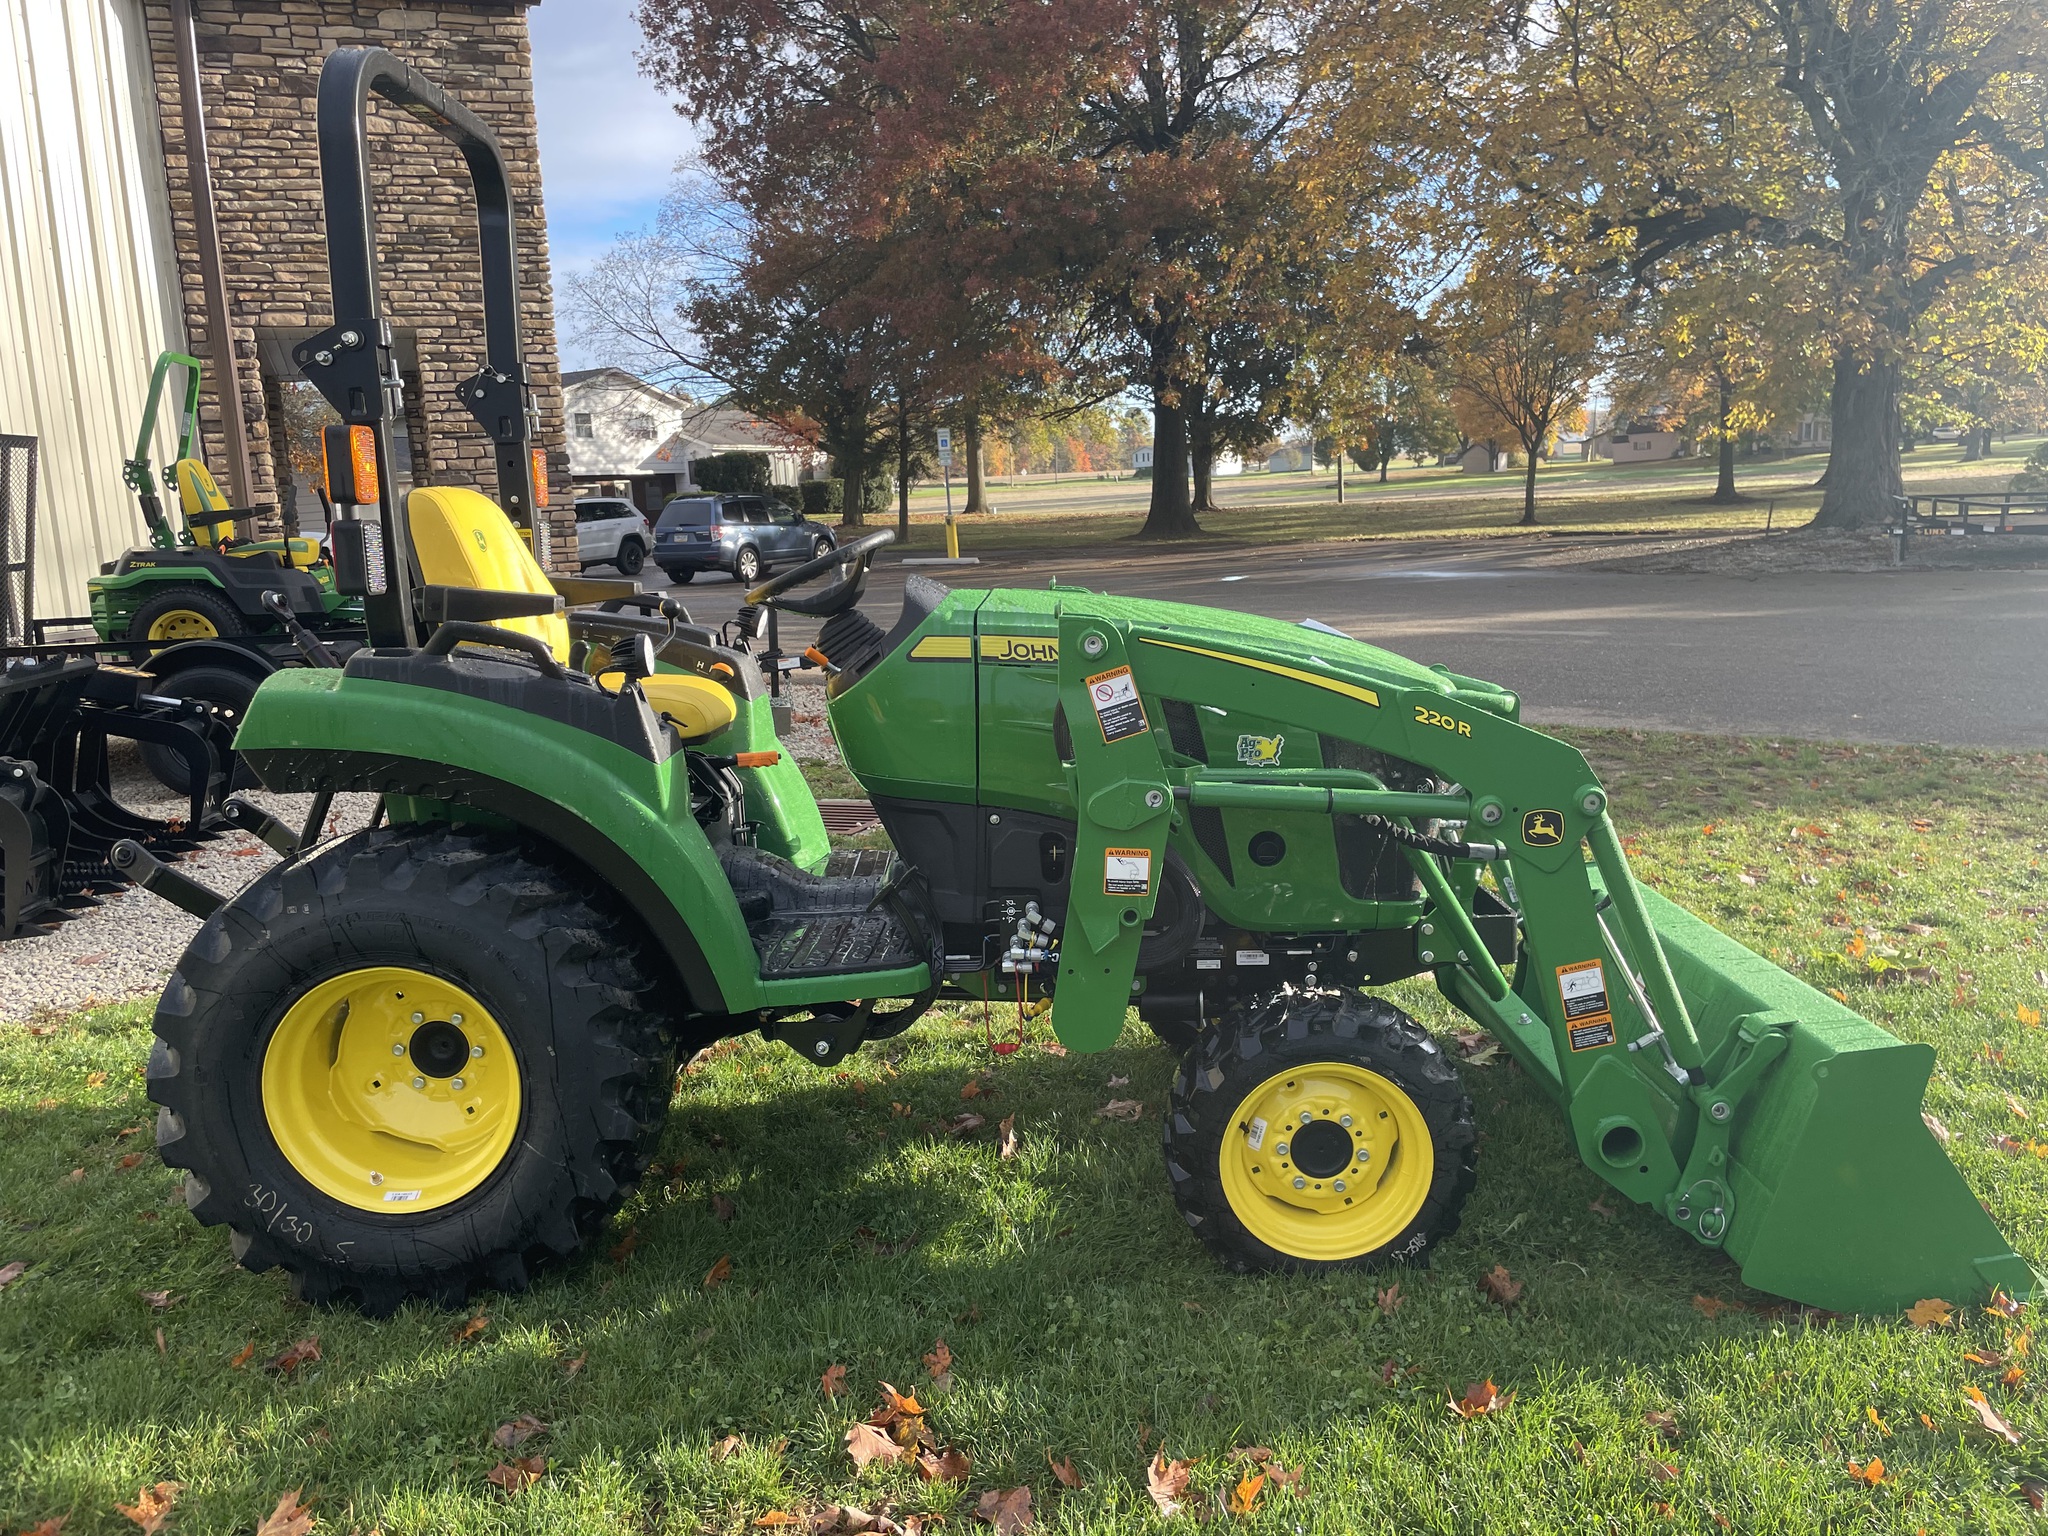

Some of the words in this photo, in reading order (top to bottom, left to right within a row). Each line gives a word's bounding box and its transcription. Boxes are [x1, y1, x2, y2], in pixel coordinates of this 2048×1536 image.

[1095, 667, 1128, 682] WARNING
[1114, 849, 1149, 857] WARNING
[1568, 961, 1597, 972] WARNING
[1579, 1016, 1608, 1027] WARNING
